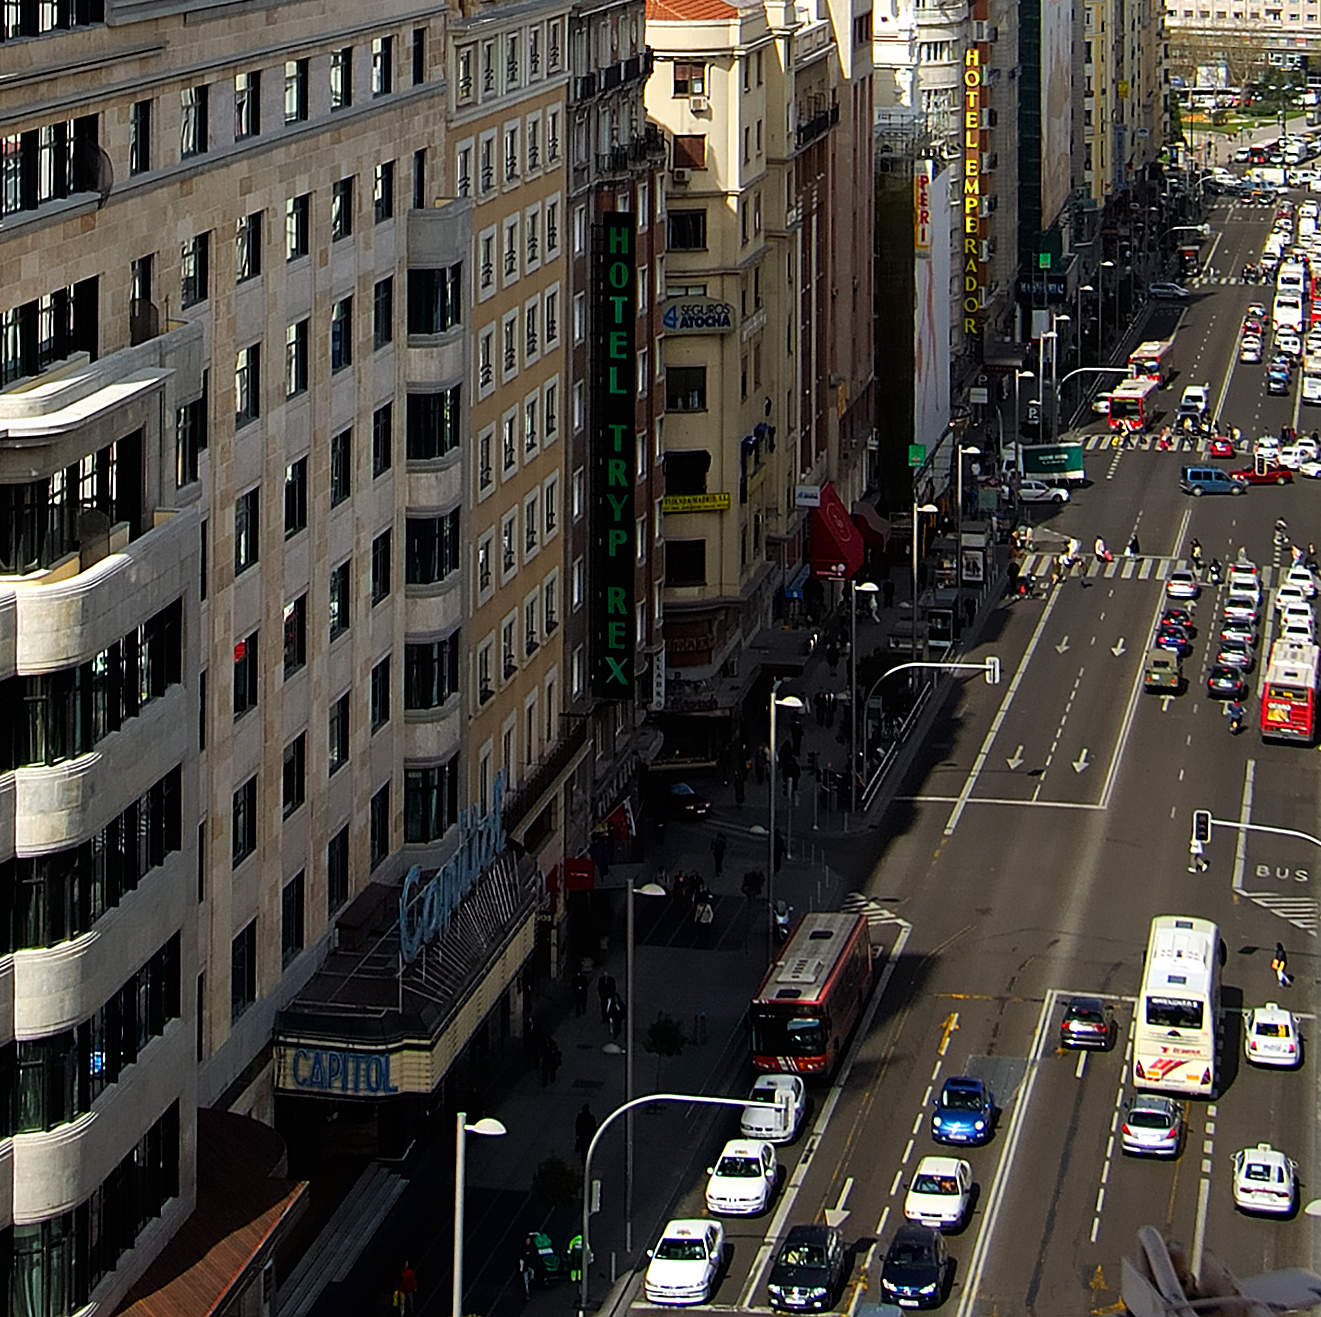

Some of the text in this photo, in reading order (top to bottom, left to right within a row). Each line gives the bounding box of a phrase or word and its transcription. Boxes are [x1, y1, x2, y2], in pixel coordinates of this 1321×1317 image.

[919, 175, 930, 242] PERI
[963, 48, 979, 334] HOTEL EMPERADOR
[680, 304, 731, 316] SEGUROS
[680, 314, 731, 328] ATOCHA
[606, 226, 629, 685] HOTEL TRYP REX
[1255, 864, 1309, 882] BUS
[293, 1048, 399, 1093] CAPITOL
